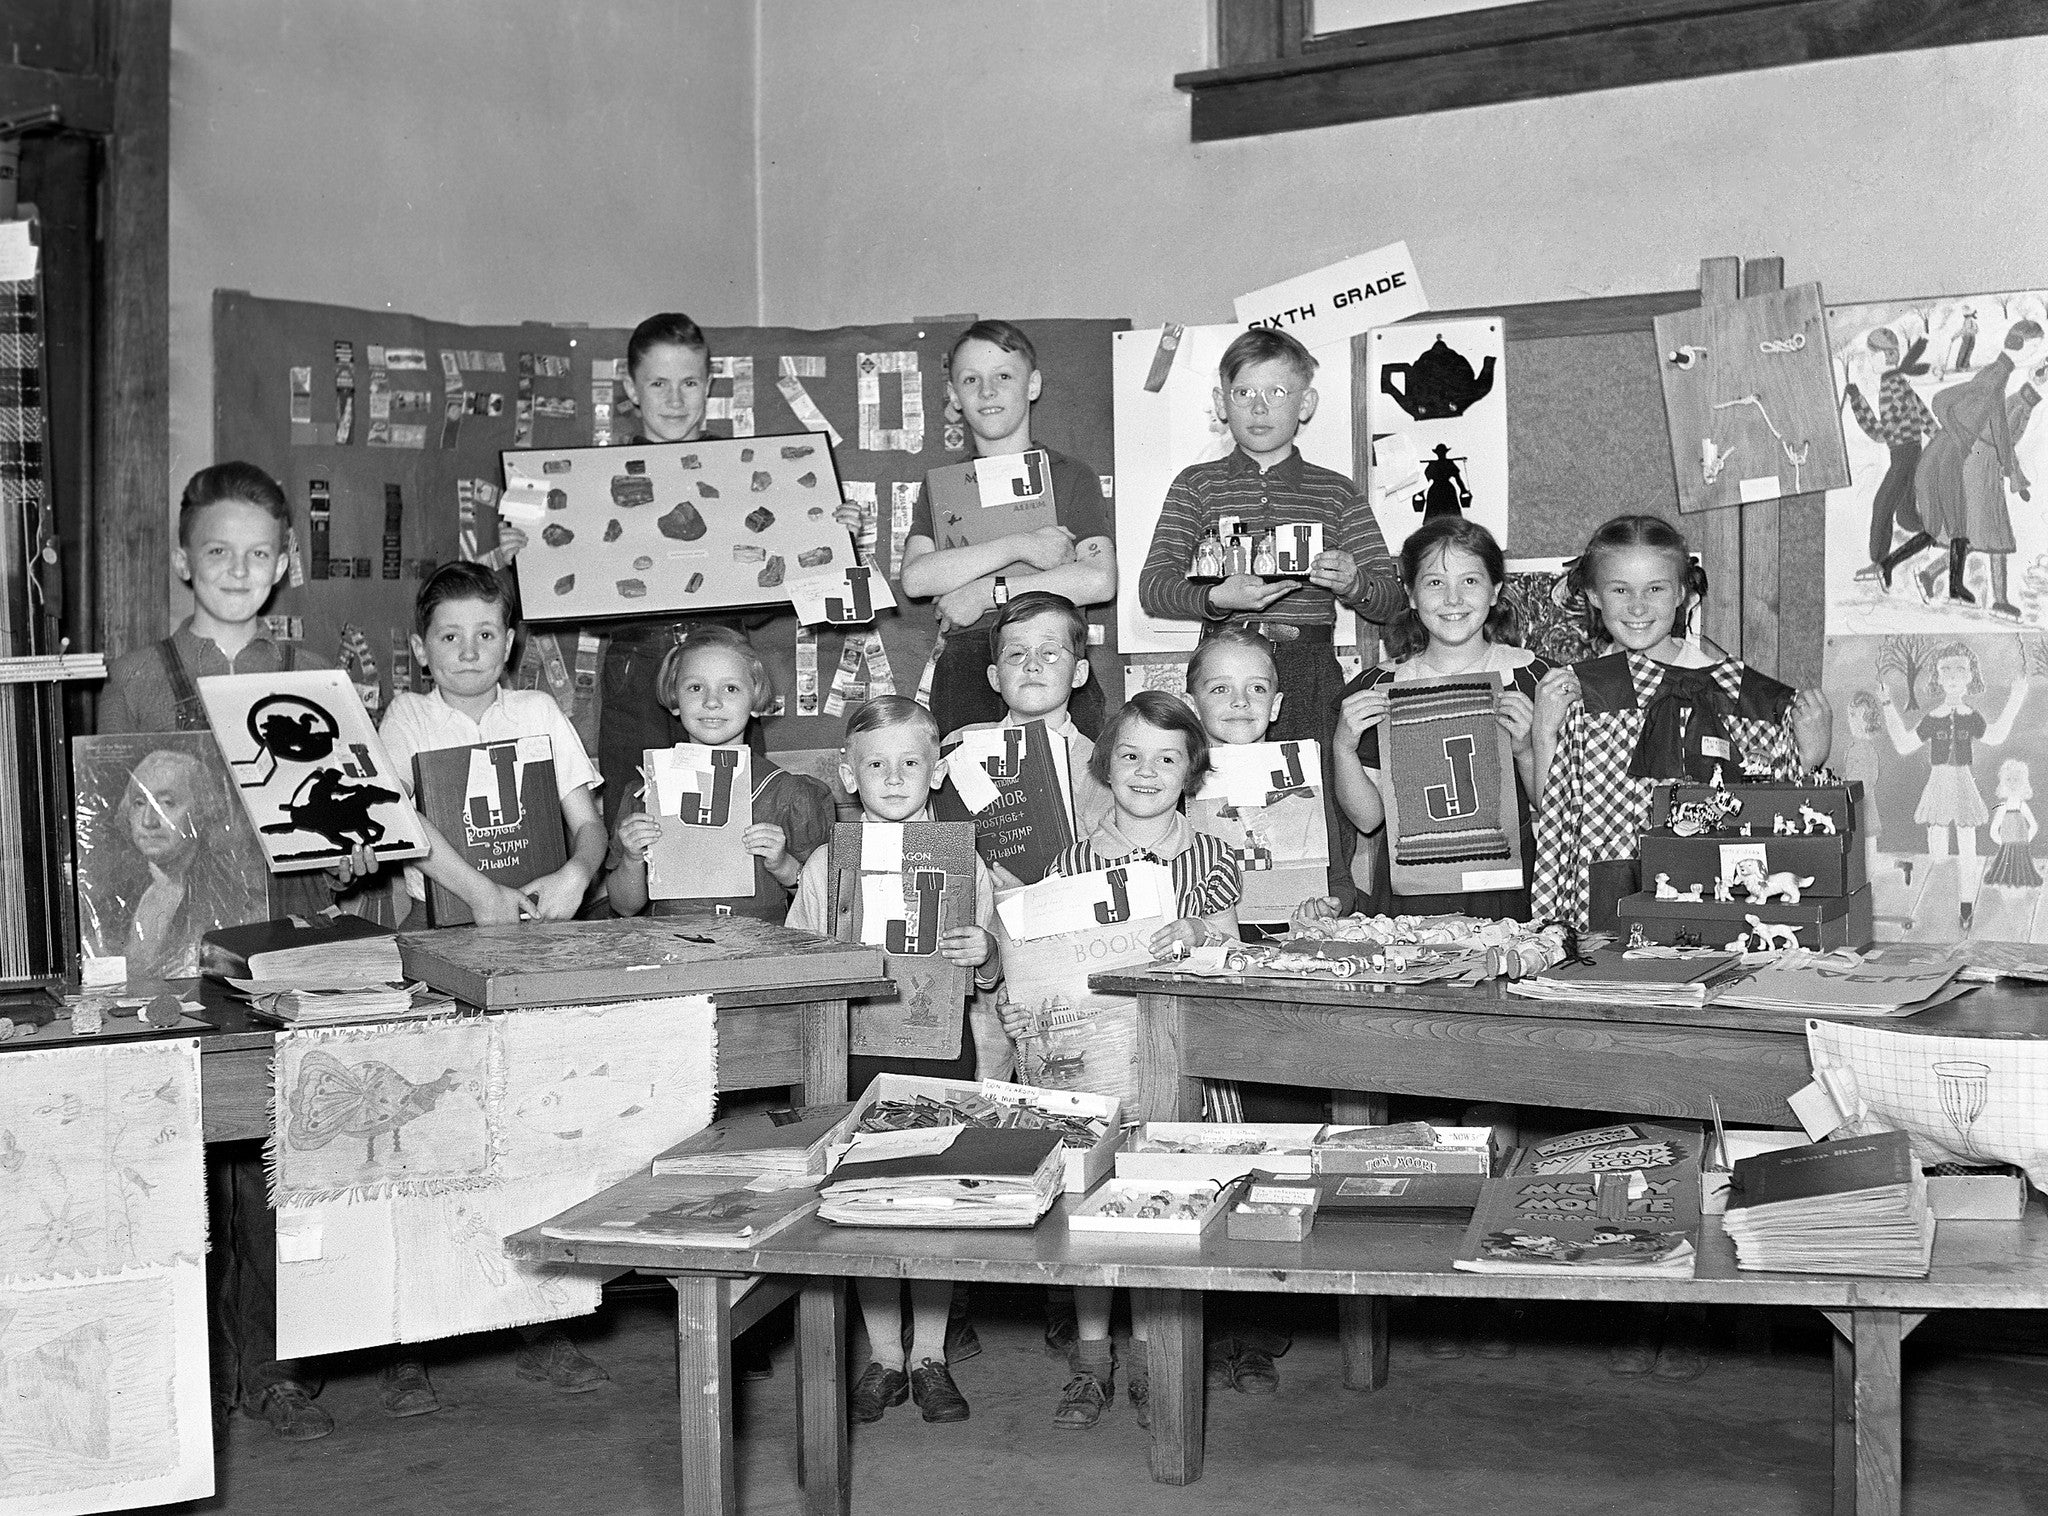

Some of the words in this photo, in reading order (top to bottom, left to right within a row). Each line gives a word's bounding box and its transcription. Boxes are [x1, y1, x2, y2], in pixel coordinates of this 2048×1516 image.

[1333, 271, 1406, 309] GRADE
[1012, 452, 1043, 497] J
[1279, 525, 1312, 572] J
[825, 566, 874, 622] J
[342, 743, 378, 778] J
[986, 728, 1023, 780] J
[1271, 742, 1306, 790] J
[468, 744, 523, 831] J
[679, 748, 739, 829] J
[1424, 734, 1480, 822] J
[493, 838, 529, 855] STAMP
[986, 843, 1026, 861] ALBUM
[998, 825, 1033, 845] STAMP
[477, 856, 520, 871] ALBUM
[885, 870, 946, 957] J
[1093, 867, 1131, 925] J
[1075, 929, 1150, 963] BOOK
[1365, 1153, 1392, 1172] TOM
[1392, 1155, 1437, 1174] MOORE
[1589, 1147, 1663, 1160] SCRAP
[1590, 1156, 1664, 1170] BOOK
[1516, 1178, 1681, 1196] MICY
